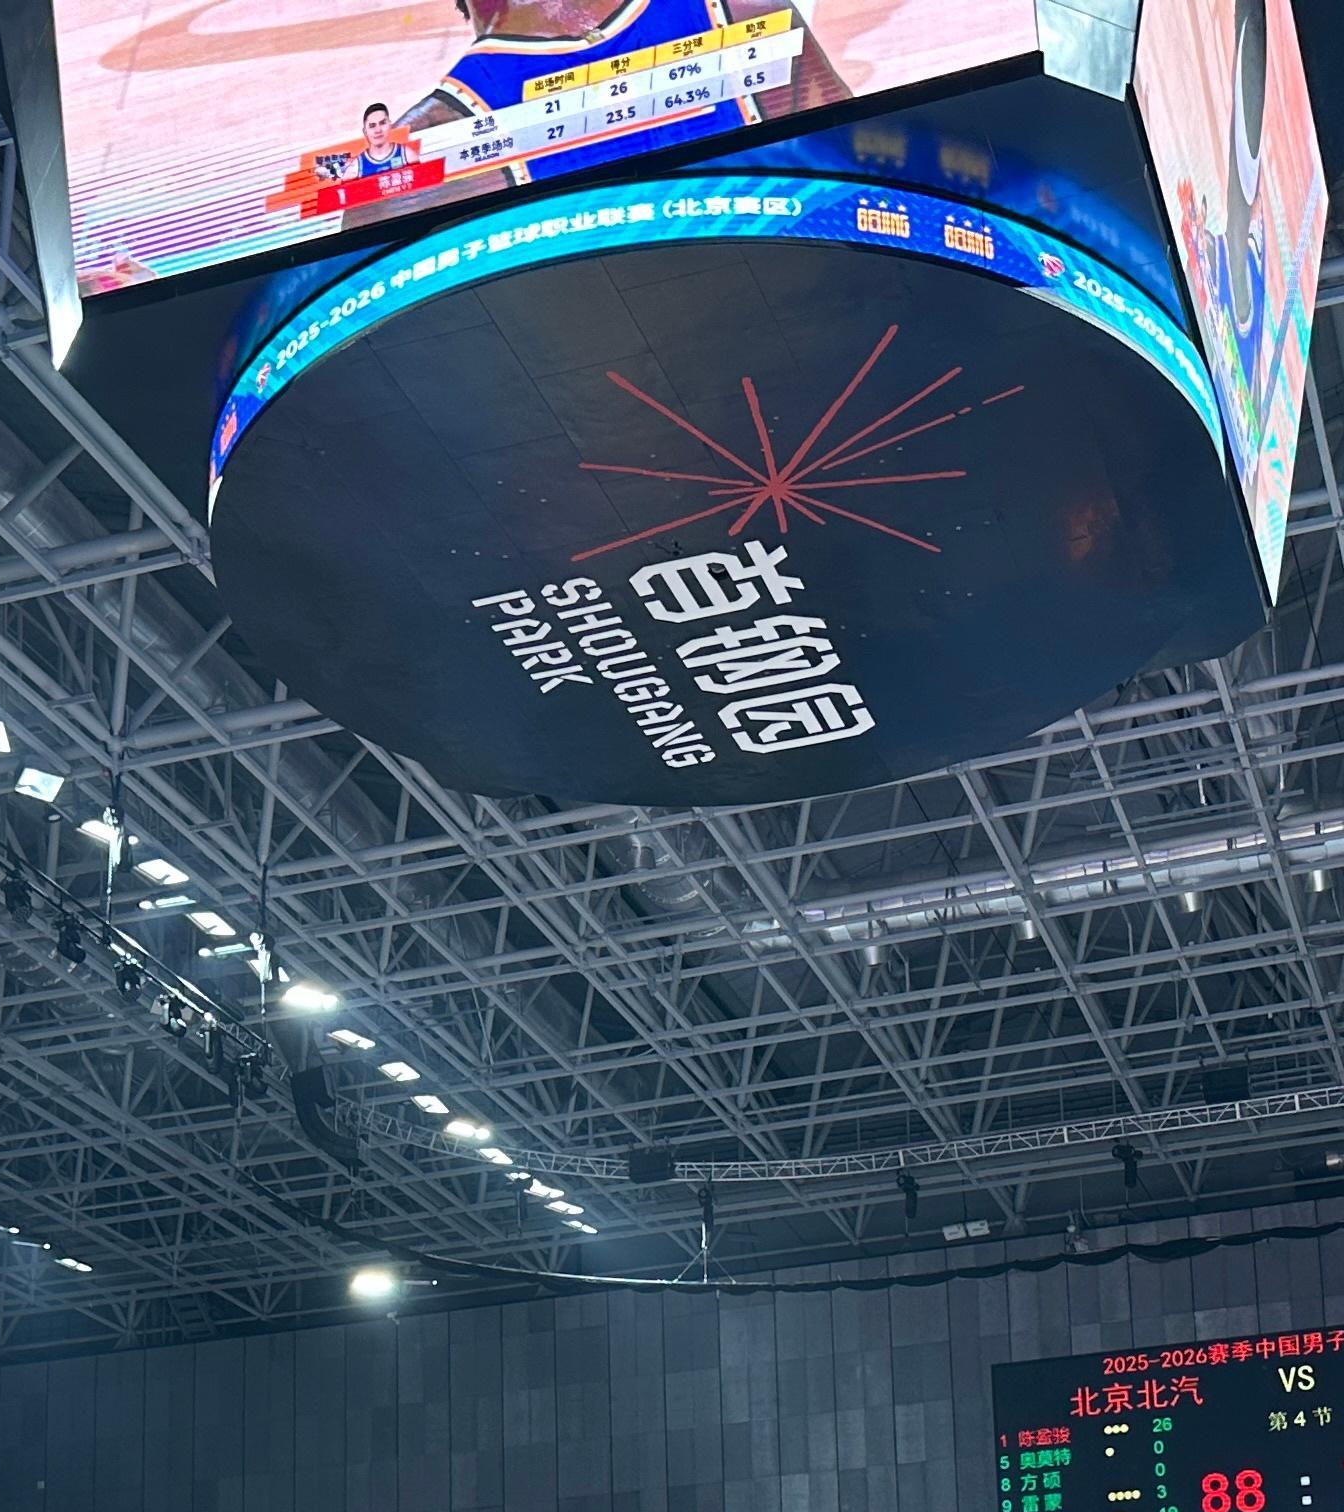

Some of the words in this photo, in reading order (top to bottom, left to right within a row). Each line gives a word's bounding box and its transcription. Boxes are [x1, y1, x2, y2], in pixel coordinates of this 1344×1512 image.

[672, 36, 703, 55] 三分球
[534, 71, 575, 91] 出场时间
[545, 99, 561, 114] 21
[610, 81, 628, 97] 26
[668, 62, 702, 80] 67%
[748, 47, 757, 60] 2
[547, 125, 565, 140] 27
[606, 105, 636, 124] 23.5
[664, 87, 711, 109] 64.3%
[743, 71, 766, 88] 6.5
[473, 116, 495, 131] 本场
[459, 137, 514, 161] 本赛季场均
[857, 207, 910, 240] BEIJING
[943, 224, 995, 261] BEIJING
[276, 281, 386, 369] 2025-2026
[471, 589, 594, 695] PARK
[628, 539, 876, 754] 首钢园
[541, 577, 716, 769] SHOUGANG
[1278, 1364, 1316, 1393] VS
[1070, 1375, 1204, 1418] 北京北汽
[1000, 1434, 1007, 1447] 1
[1152, 1417, 1173, 1433] 26
[1000, 1456, 1010, 1470] 5
[1154, 1441, 1164, 1455] 0
[1001, 1478, 1011, 1492] 8
[1155, 1463, 1166, 1477] 0
[1002, 1500, 1011, 1512] 9
[1157, 1485, 1167, 1499] 3
